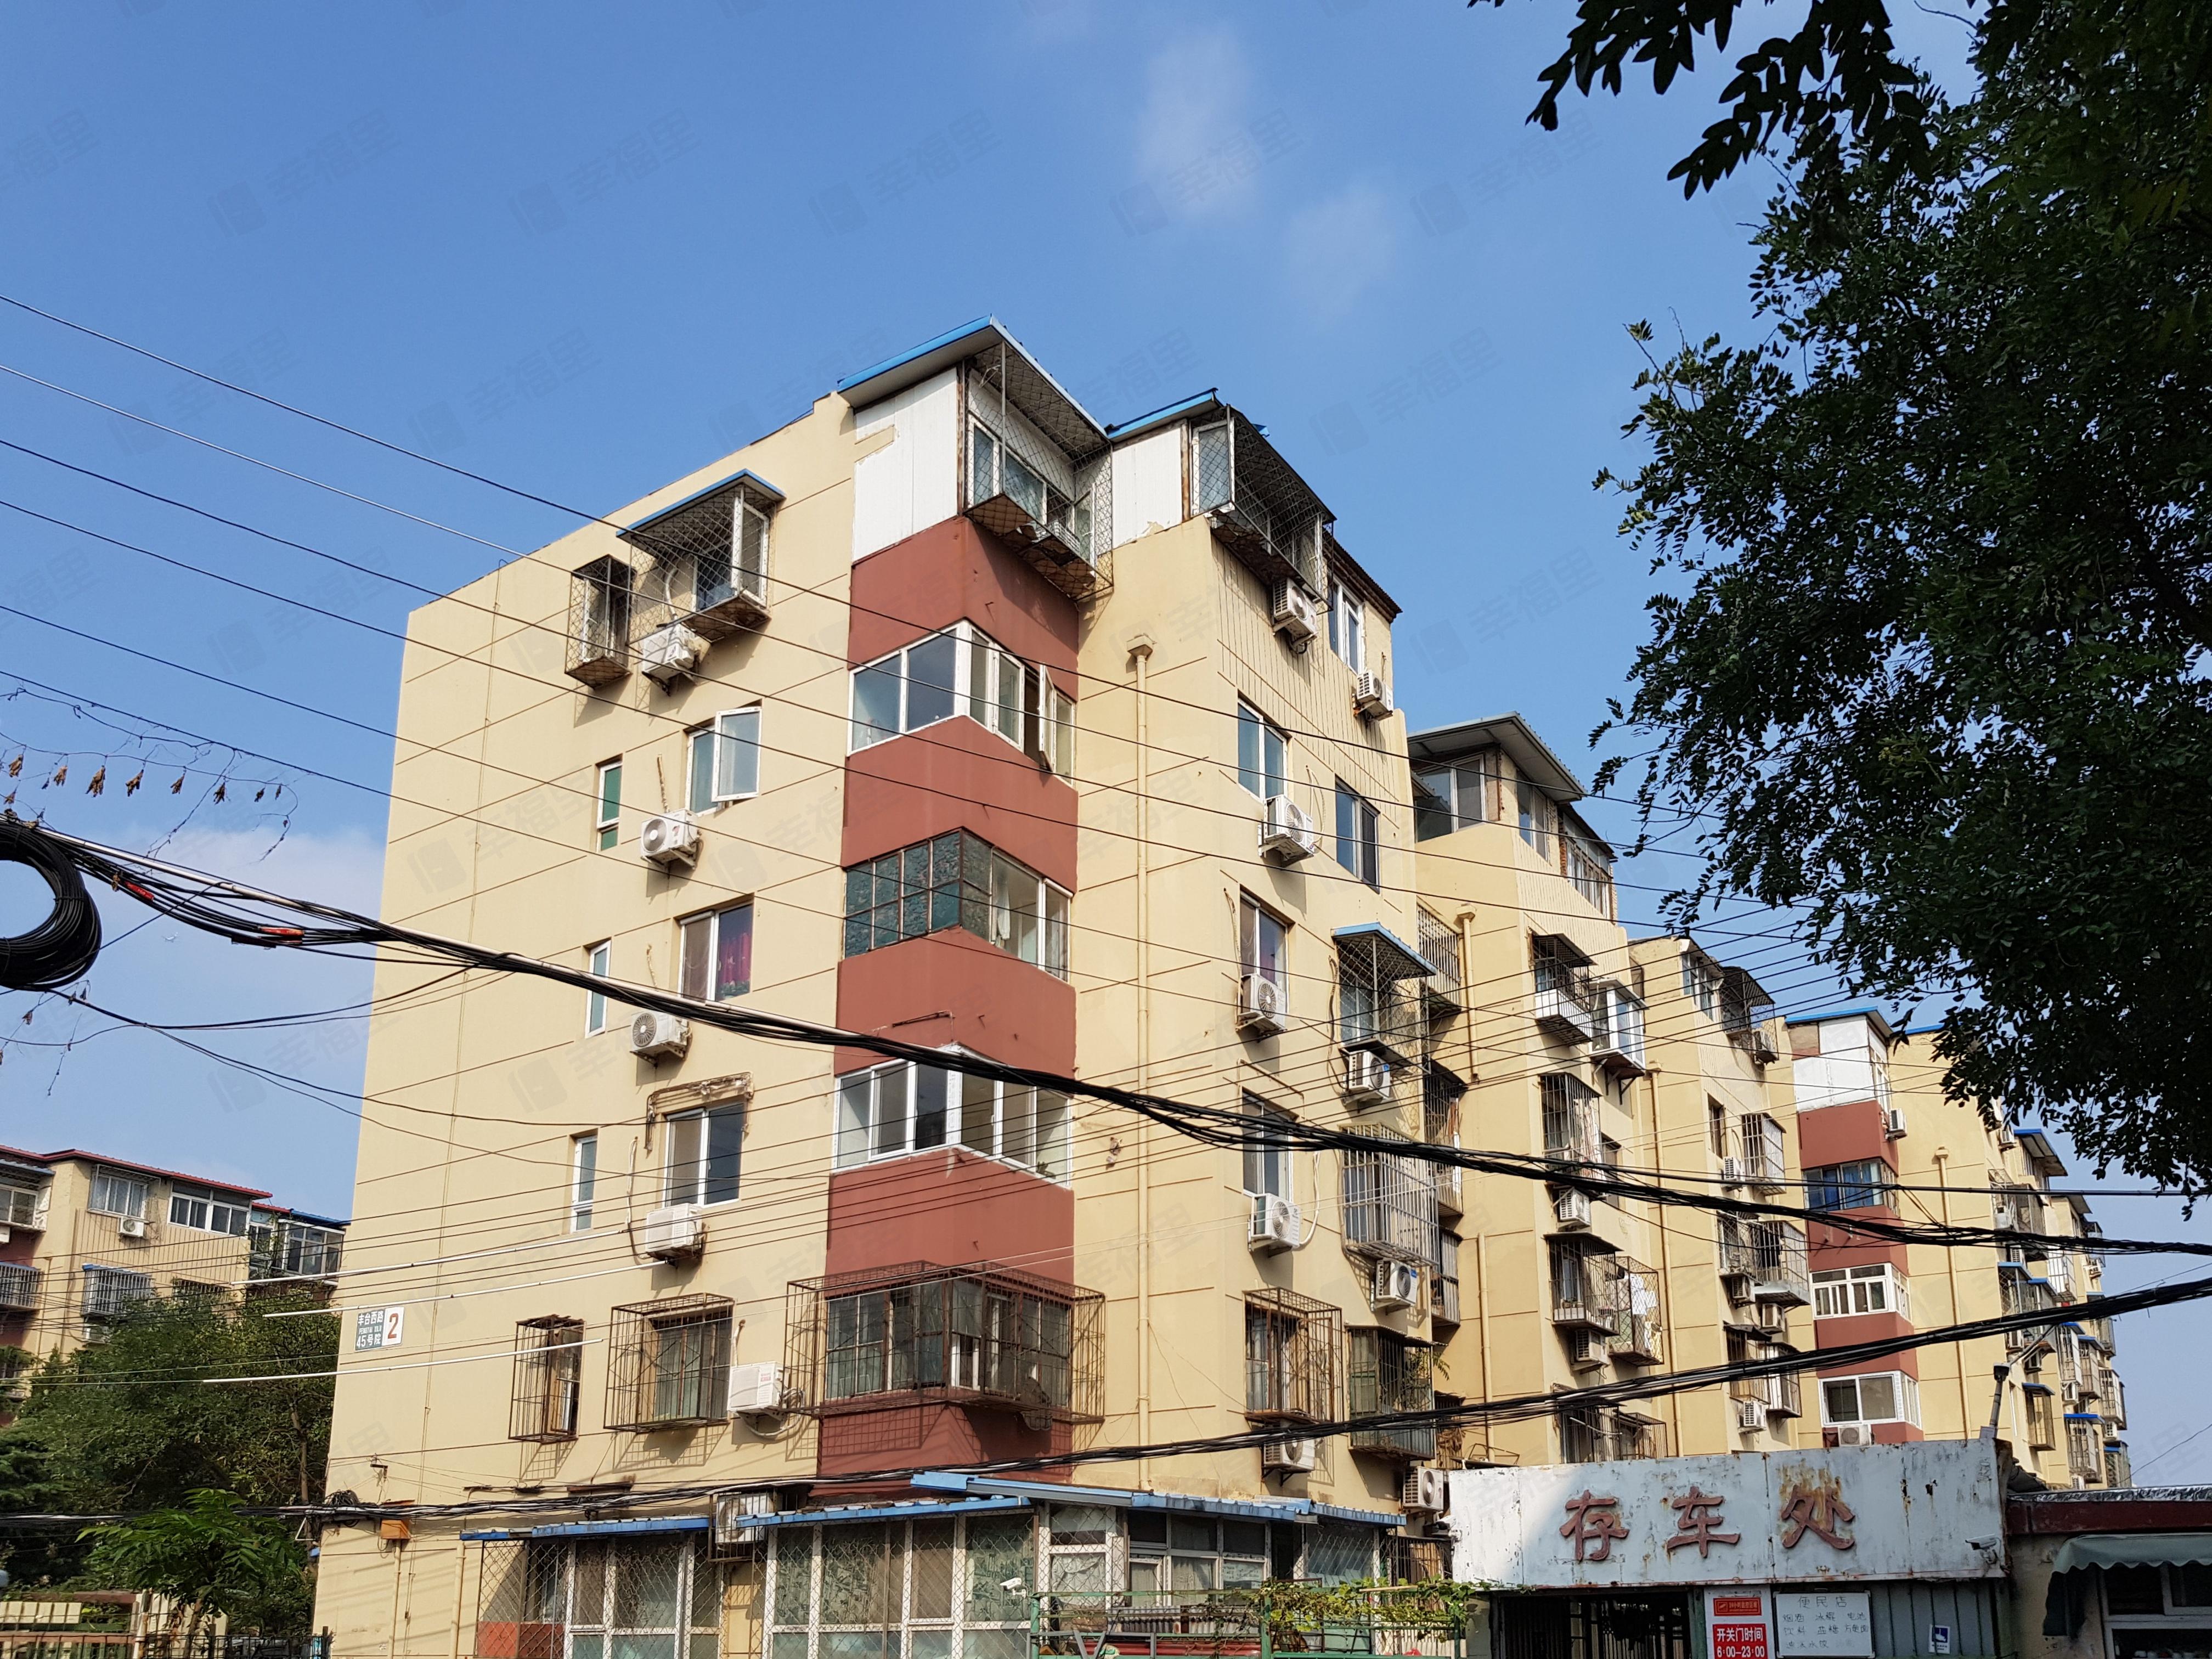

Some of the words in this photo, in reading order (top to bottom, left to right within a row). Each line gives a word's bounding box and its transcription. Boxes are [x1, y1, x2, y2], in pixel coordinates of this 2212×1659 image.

[358, 1311, 383, 1325] 丰台西路
[388, 1313, 399, 1339] 2
[357, 1334, 381, 1347] 45号院
[1559, 1484, 1855, 1562] 存车处
[1798, 1595, 1847, 1609] 便民店
[1783, 1613, 1804, 1622] 烟酒
[1847, 1612, 1867, 1621] 电池
[1717, 1627, 1763, 1642] 开关门时间
[1784, 1626, 1805, 1635] 饮料
[1845, 1623, 1869, 1633] 方便面
